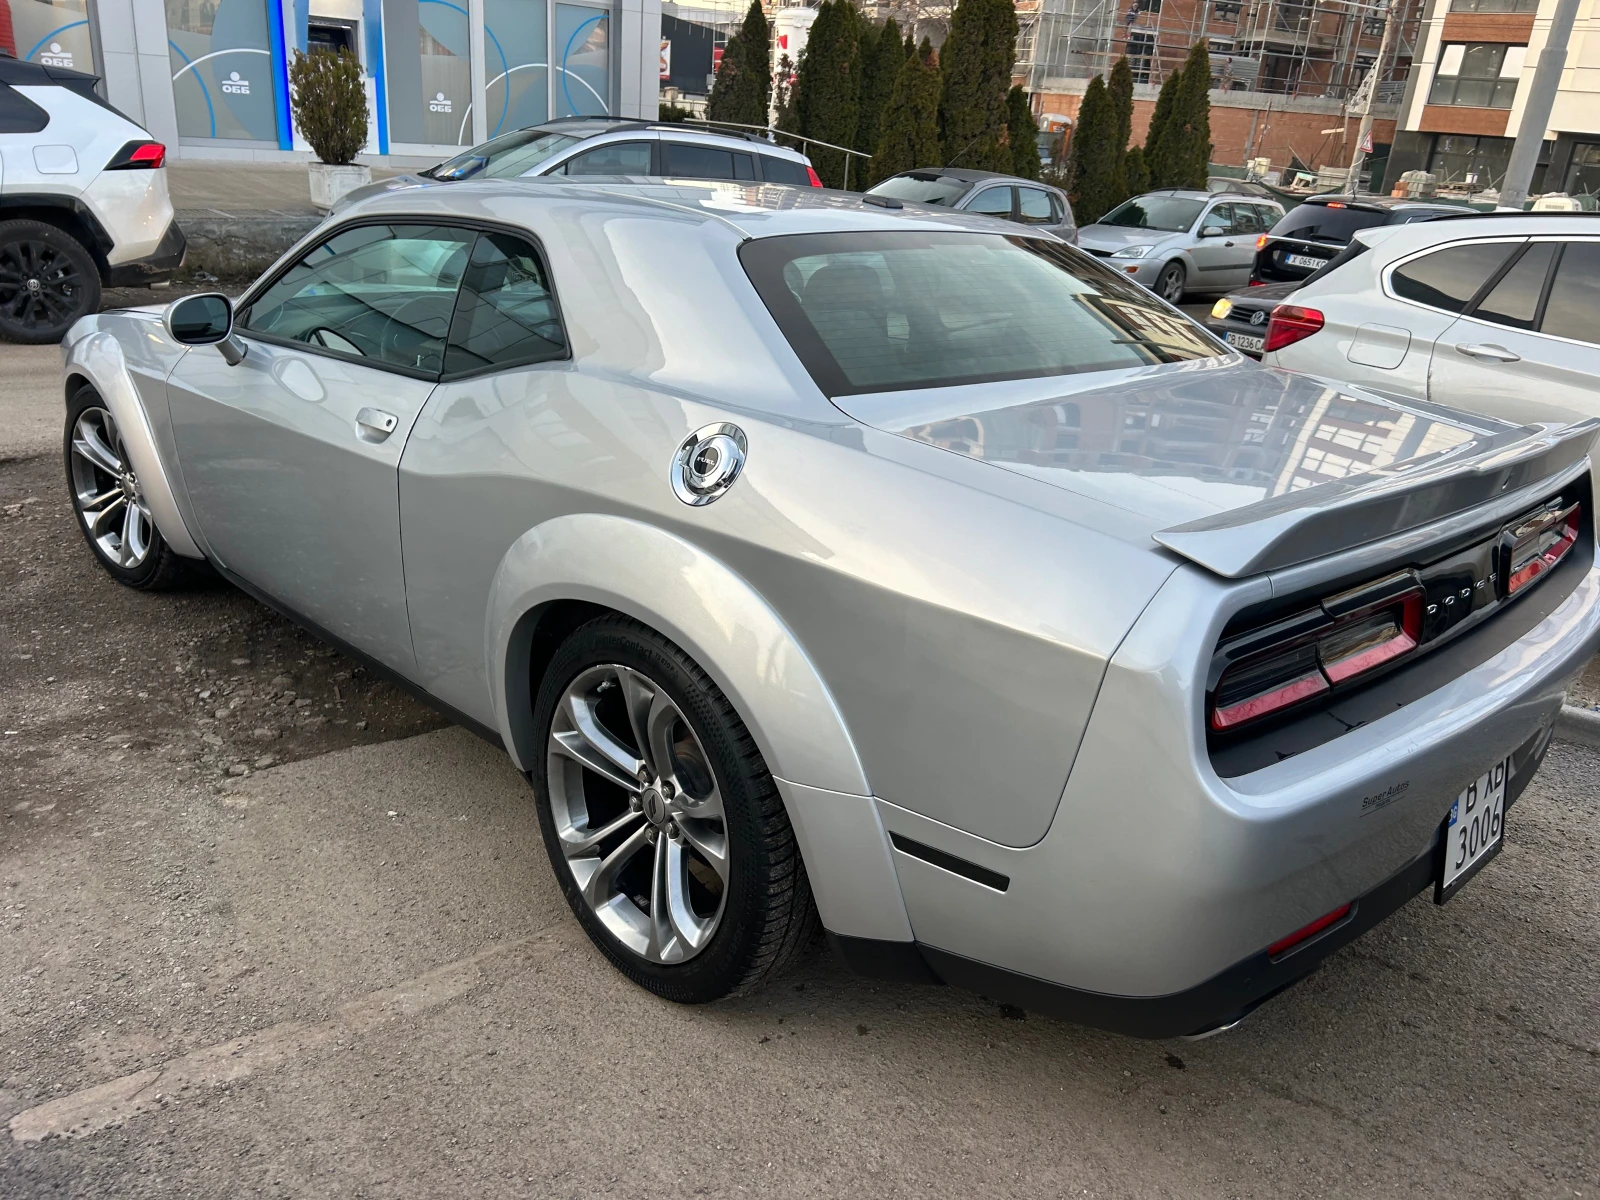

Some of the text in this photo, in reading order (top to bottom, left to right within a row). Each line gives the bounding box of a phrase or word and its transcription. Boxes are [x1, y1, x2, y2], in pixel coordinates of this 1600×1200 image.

[40, 58, 74, 68] ОББ
[221, 84, 251, 95] ОББ
[429, 103, 452, 113] ОББ
[1237, 335, 1255, 350] 1236
[696, 456, 715, 466] FUEL
[1426, 572, 1497, 615] DODGE
[593, 633, 653, 660] WinterContact
[1454, 792, 1501, 871] 3006
